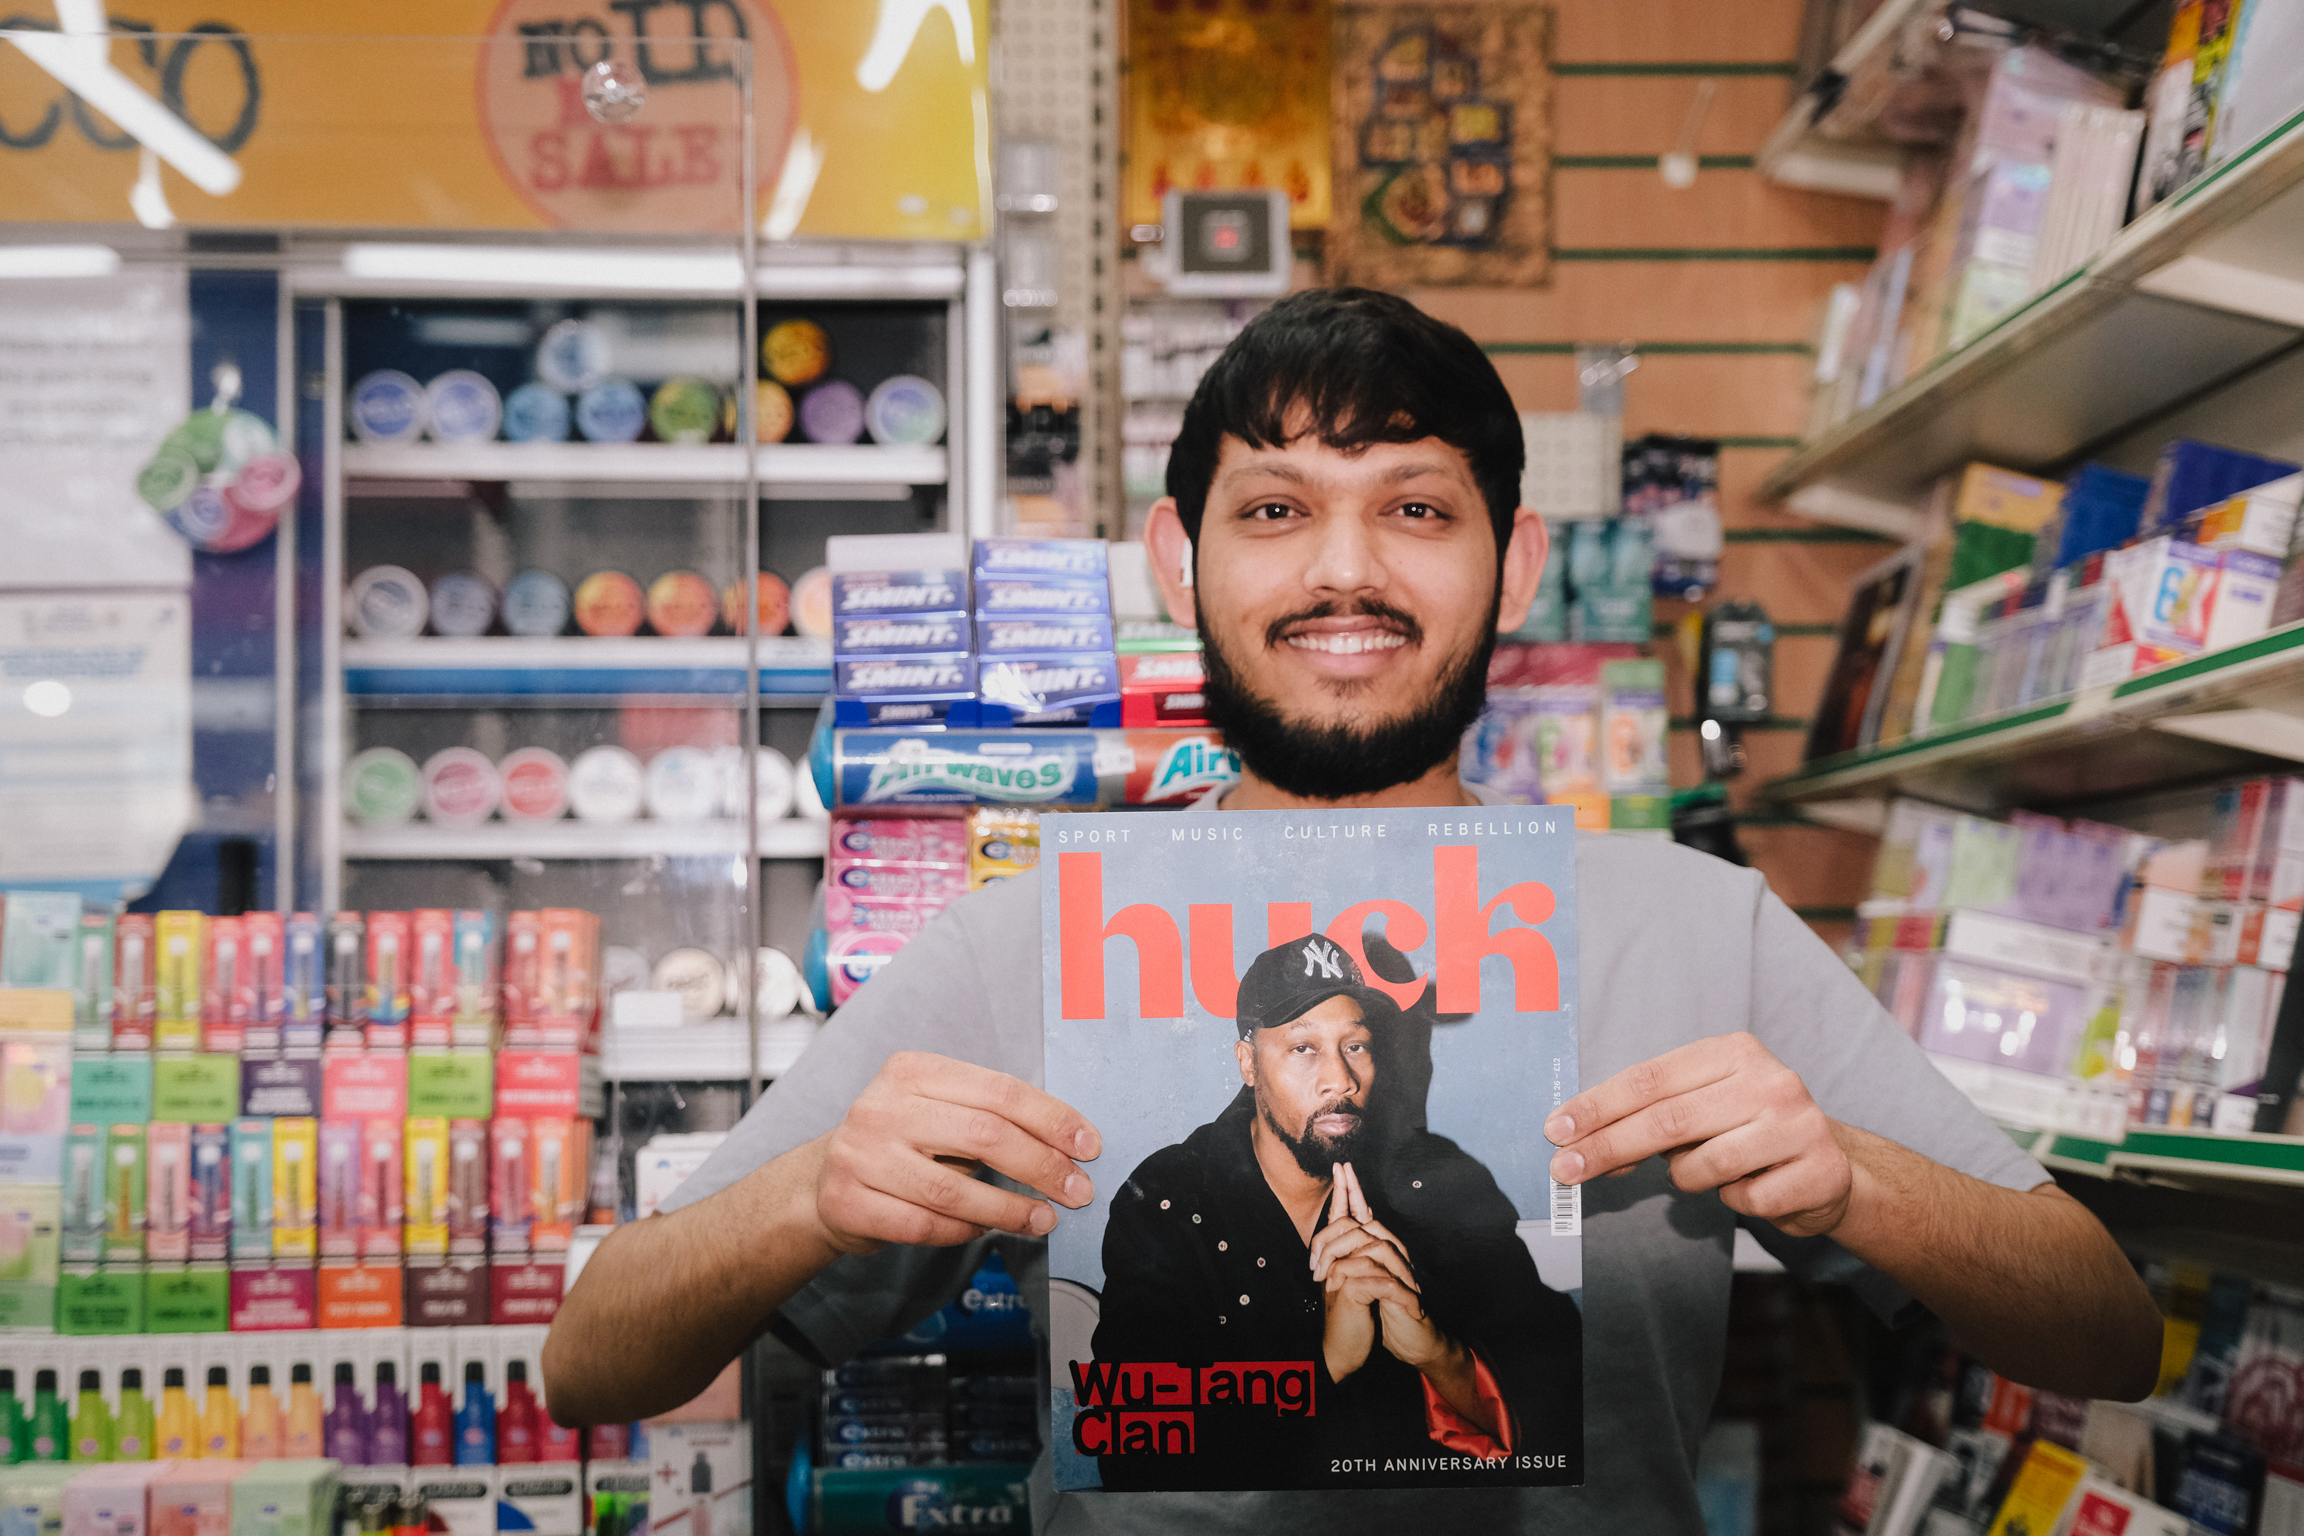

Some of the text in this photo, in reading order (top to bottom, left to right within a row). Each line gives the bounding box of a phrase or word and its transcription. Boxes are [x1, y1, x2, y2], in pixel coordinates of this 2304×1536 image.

[876, 737, 1064, 790] Airwaves
[1058, 820, 1556, 844] SPORT MUSIC CULTURE REBELLION
[1058, 845, 1560, 1020] huck
[1302, 938, 1344, 979] NY
[1552, 1057, 1561, 1071] £12
[1553, 1080, 1561, 1090] 26
[1553, 1092, 1561, 1106] S/S
[1068, 1359, 1312, 1418] Wu-Tang
[1072, 1408, 1194, 1457] Clan
[1330, 1454, 1567, 1473] 20TH ANNIVERSARY ISSUE
[901, 1493, 1012, 1527] Extra
